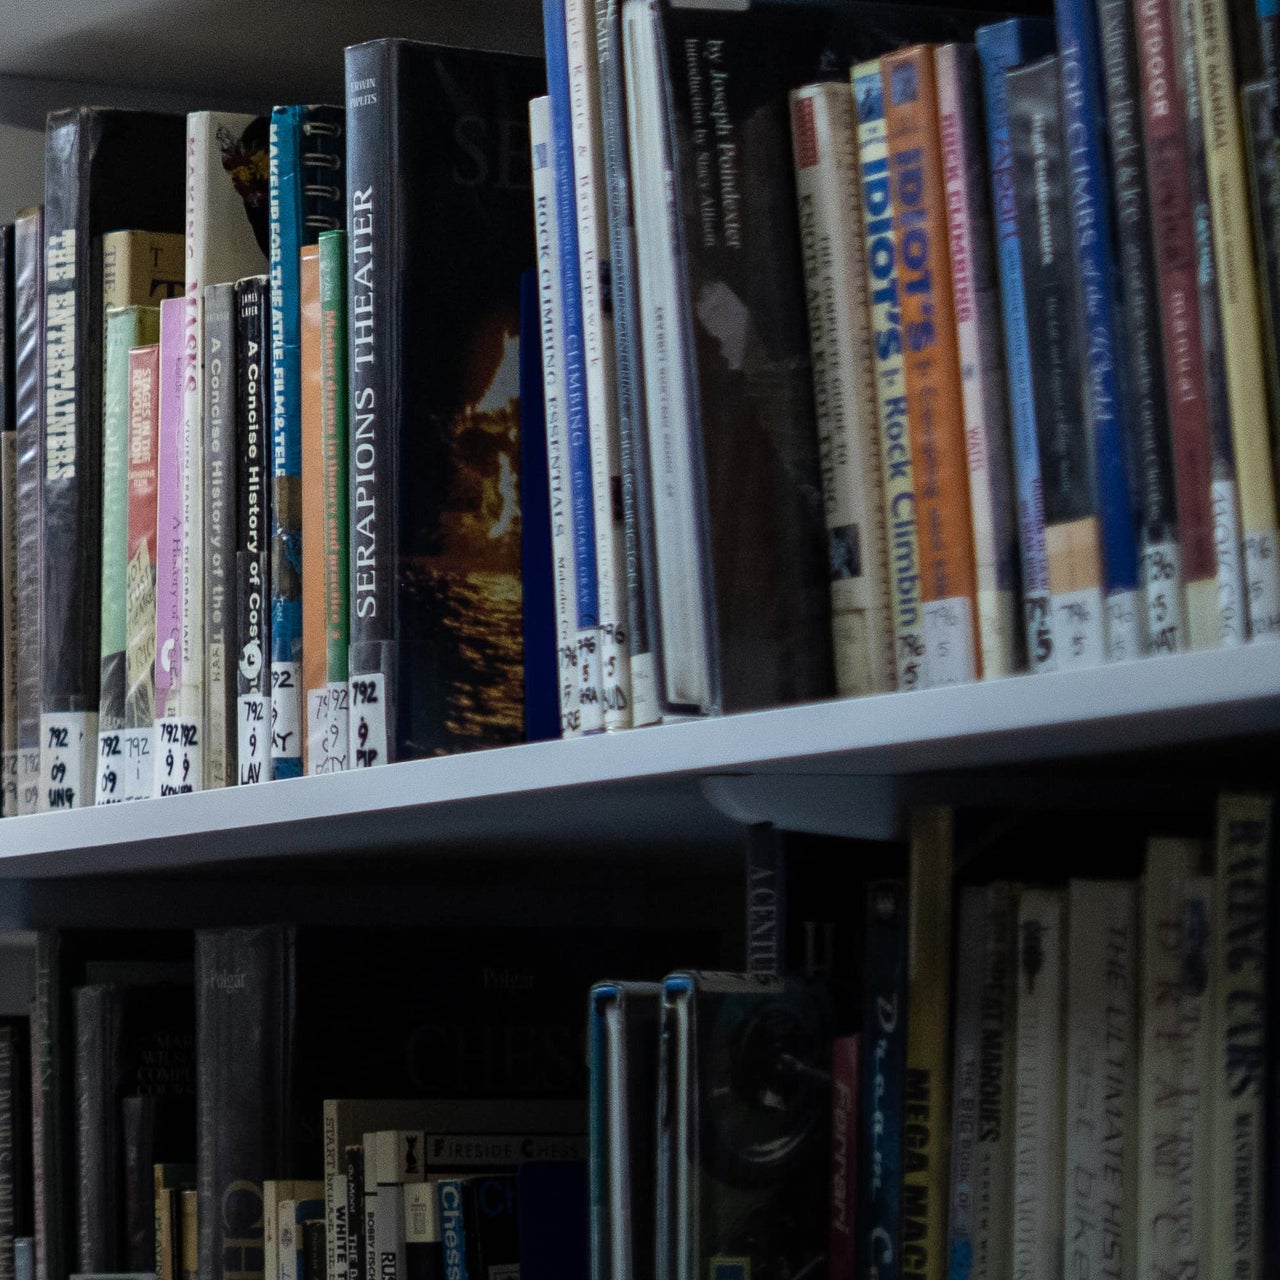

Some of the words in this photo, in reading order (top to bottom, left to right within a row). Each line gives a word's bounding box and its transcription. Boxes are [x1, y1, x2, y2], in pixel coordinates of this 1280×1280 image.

[707, 38, 726, 63] by
[1062, 42, 1083, 108] TOP
[1102, 0, 1129, 94] Extreme
[349, 77, 376, 93] ERWIN
[572, 64, 586, 131] Knots
[685, 37, 708, 126] Introduction
[710, 68, 734, 136] Joseph
[1206, 64, 1228, 149] MANUAL
[694, 129, 711, 144] by
[941, 112, 960, 183] ROCK
[1031, 112, 1048, 154] High
[1114, 101, 1139, 161] Rock
[186, 137, 198, 259] MAKING
[695, 150, 714, 190] Stacy
[720, 143, 742, 249] Poindexter
[1068, 121, 1096, 246] CLIMBS
[1118, 166, 1137, 185] &
[535, 195, 550, 260] ROCK
[580, 174, 594, 236] Basic
[702, 194, 719, 247] Allison
[801, 194, 818, 276] KNOTS
[1035, 158, 1055, 267] Endeavours
[1121, 187, 1141, 222] Ice
[47, 228, 77, 282] THE
[354, 187, 375, 372] THEATER
[861, 156, 904, 362] IDIOT'S
[893, 147, 937, 352] IDIOT'S
[948, 190, 972, 323] CLIMBING
[1079, 257, 1099, 275] of
[539, 268, 559, 387] CLIMBING
[582, 250, 601, 368] Ropework
[807, 287, 824, 340] AND
[1086, 283, 1104, 316] the
[210, 337, 222, 354] A
[246, 340, 259, 357] A
[325, 310, 341, 378] Modern
[1088, 325, 1113, 420] World
[1172, 290, 1196, 403] manual
[45, 289, 77, 482] ENTERTAINERS
[130, 368, 143, 464] REVOLUTION
[141, 367, 152, 413] STAGES
[210, 357, 224, 457] Concise
[246, 358, 260, 457] Concise
[273, 369, 289, 415] FILM
[566, 333, 584, 447] CLIMBING
[811, 351, 831, 420] KNOT
[141, 416, 152, 427] IN
[141, 430, 153, 462] THE
[885, 394, 915, 479] Rock
[547, 396, 566, 538] ESSENTIALS
[208, 461, 226, 549] History
[244, 465, 262, 554] History
[355, 387, 377, 619] SERAPIONS
[576, 496, 588, 563] MICHAEL
[623, 472, 638, 589] BONINGTON
[212, 553, 227, 578] of
[247, 561, 262, 586] of
[325, 554, 342, 623] practice
[579, 566, 590, 605] GRAY
[892, 491, 922, 628] Climbin
[212, 584, 228, 623] the
[243, 701, 264, 722] 792
[351, 681, 378, 705] 792
[47, 727, 69, 749] 792
[99, 735, 120, 757] 792
[160, 723, 181, 743] 792
[241, 762, 262, 786] LAV
[1225, 819, 1263, 975] RACING
[1104, 922, 1127, 992] THE
[1226, 989, 1263, 1100] CARS
[978, 1027, 1003, 1143] MARQUES
[1102, 1005, 1126, 1188] ULTIMATE
[325, 1116, 337, 1169] START
[433, 1138, 512, 1160] FIRESIDE
[520, 1138, 579, 1160] CHESS
[904, 1068, 931, 1173] MEGA
[831, 1078, 853, 1236] Ferrari
[336, 1205, 348, 1267] WHITE
[366, 1211, 376, 1239] BOBBY
[441, 1185, 462, 1280] Chess
